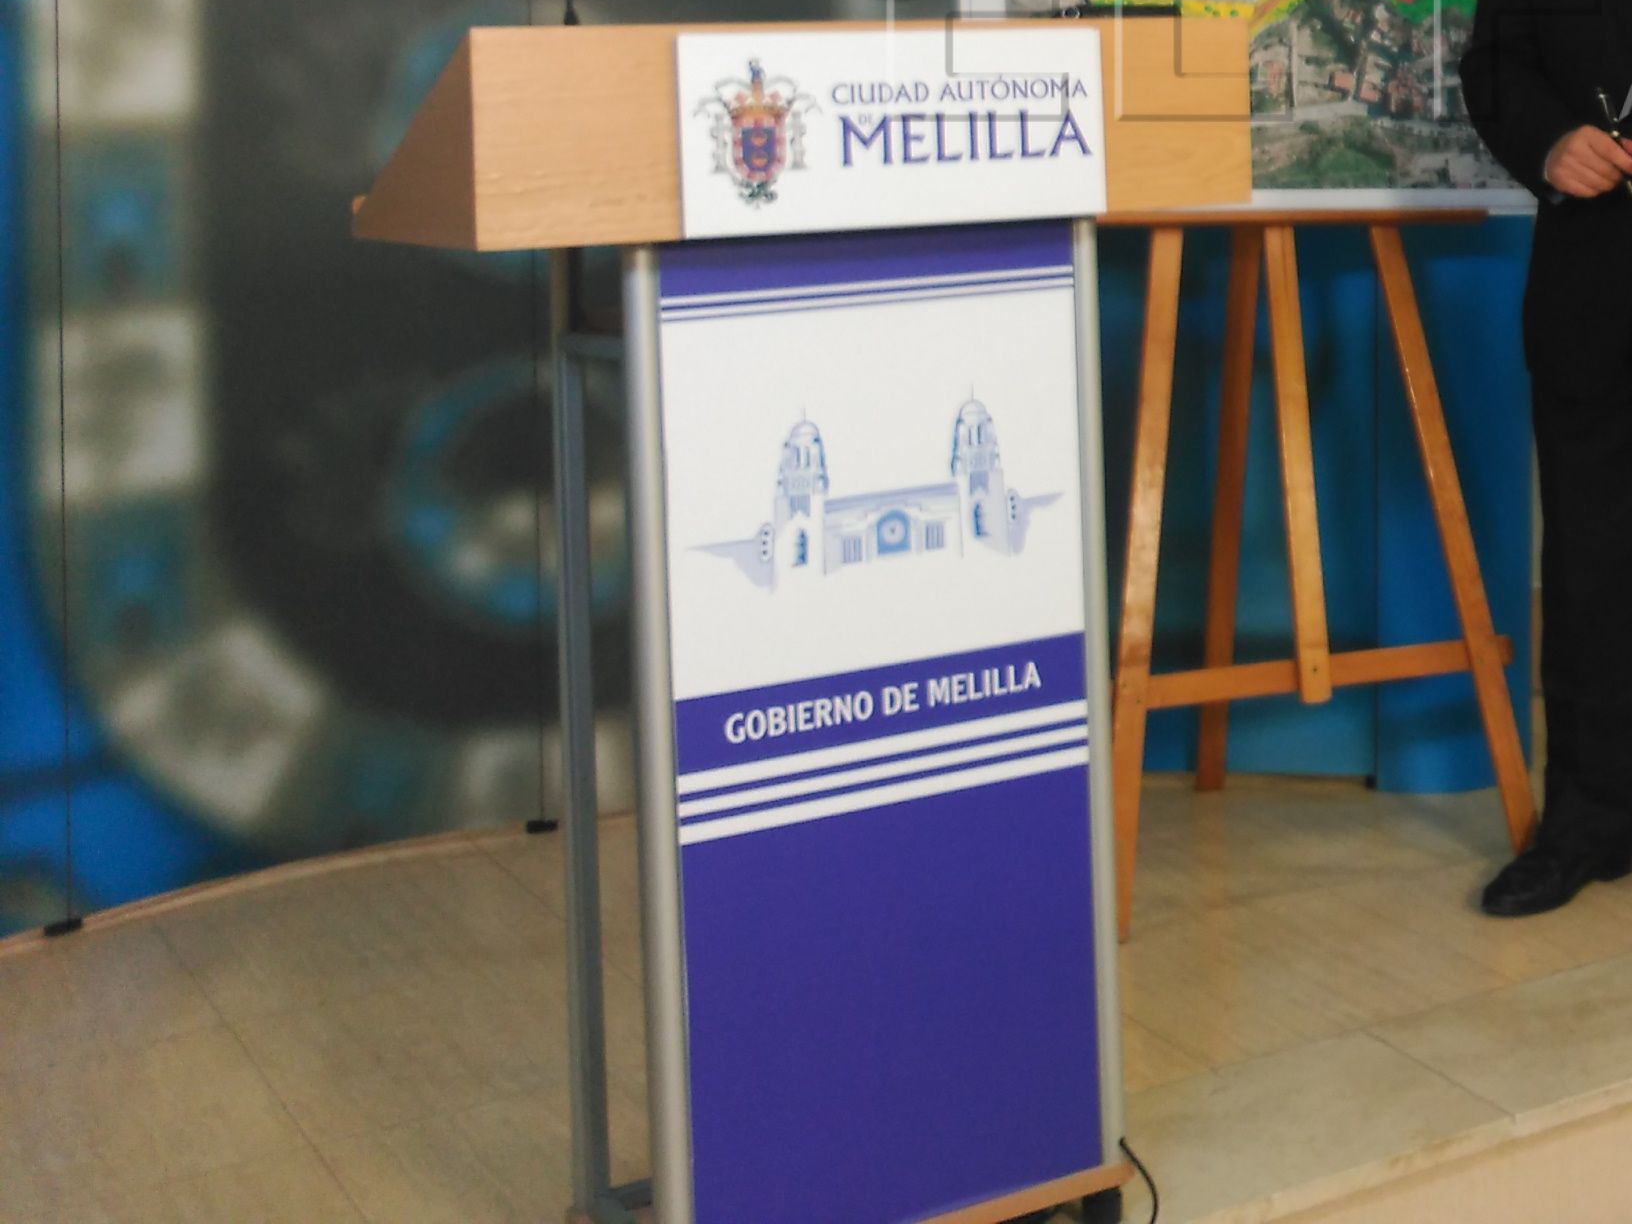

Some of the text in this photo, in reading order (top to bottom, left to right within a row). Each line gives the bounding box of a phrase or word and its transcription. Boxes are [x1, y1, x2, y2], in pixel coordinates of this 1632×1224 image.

[831, 75, 1088, 105] CIUDAD AUTÓNOMA
[839, 108, 1093, 167] DE MELILLA
[725, 661, 1042, 744] GOBIERNO DE MELILLA
